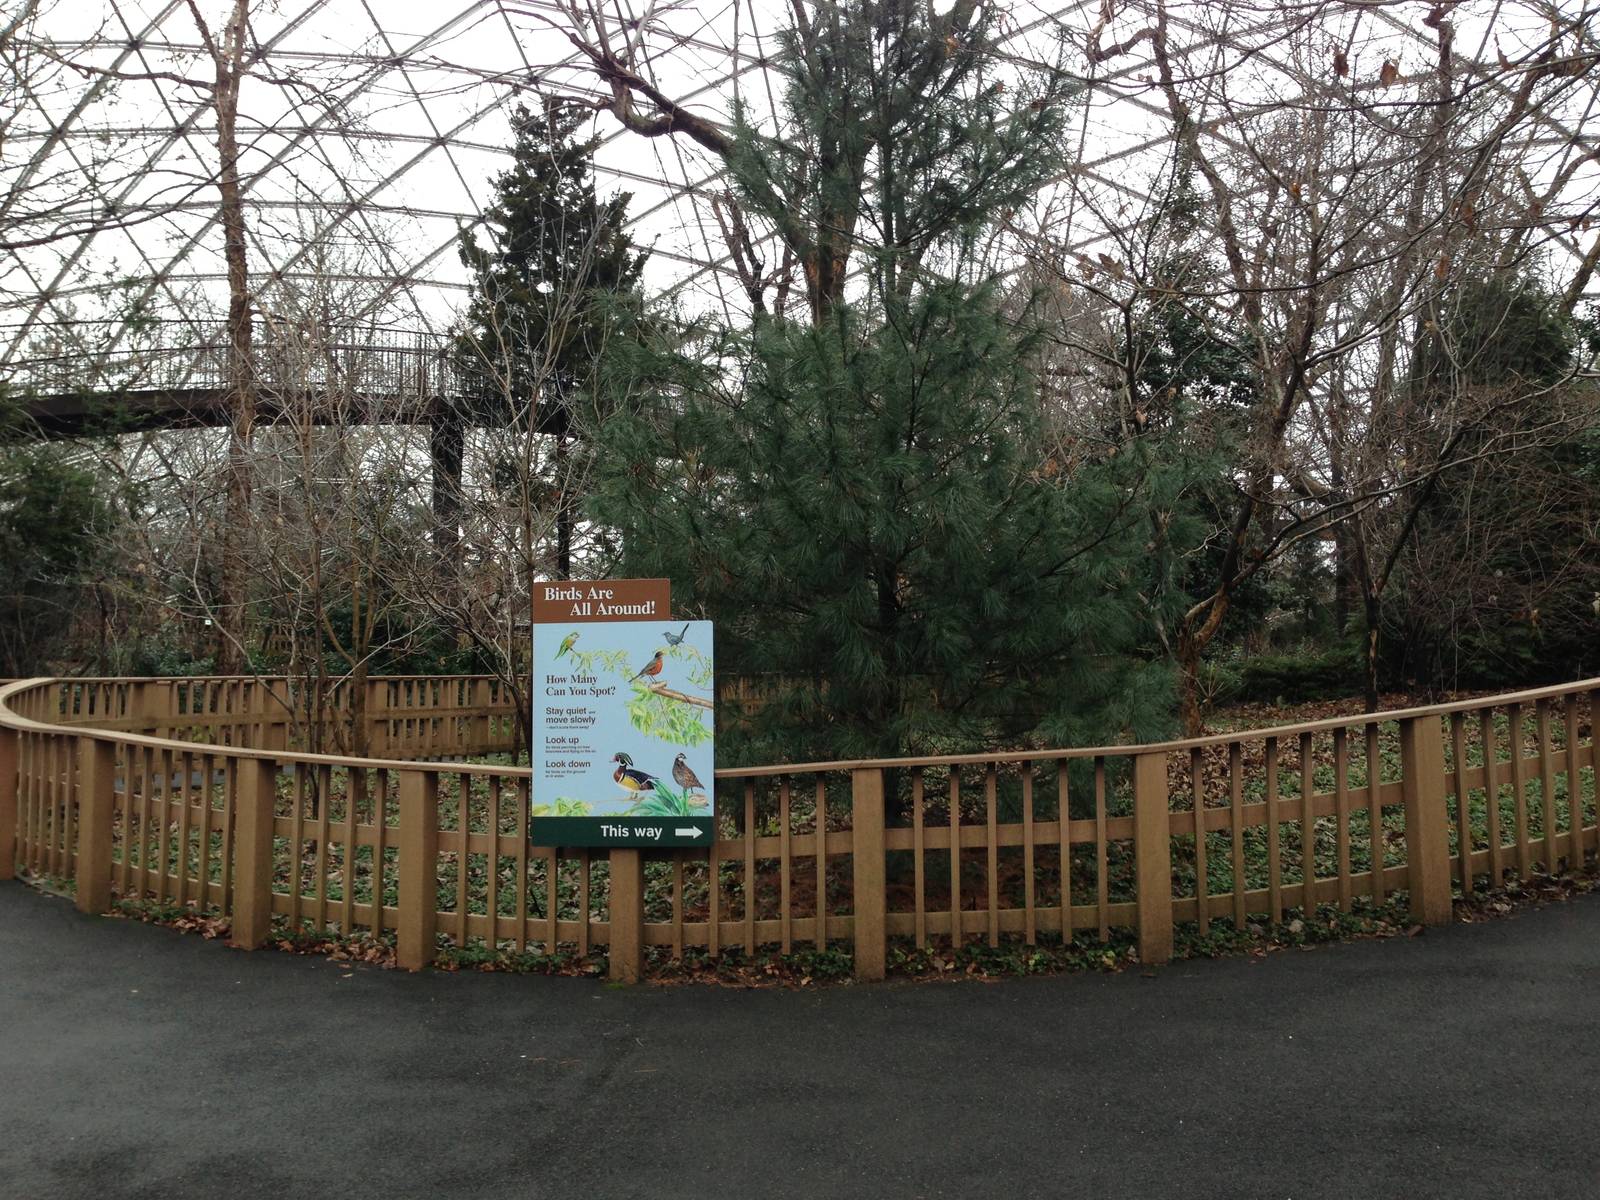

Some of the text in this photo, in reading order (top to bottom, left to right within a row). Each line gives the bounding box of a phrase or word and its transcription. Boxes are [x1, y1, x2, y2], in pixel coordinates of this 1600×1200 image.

[545, 587, 614, 601] Birds Are
[570, 601, 656, 616] All Around!
[546, 675, 597, 685] How Many
[546, 686, 616, 698] Can You Spot?
[546, 707, 563, 716] Stay
[566, 707, 587, 715] quiet
[570, 716, 596, 725] slowly
[546, 736, 566, 744] Look
[546, 760, 591, 768] Look down
[600, 824, 663, 841] This way
